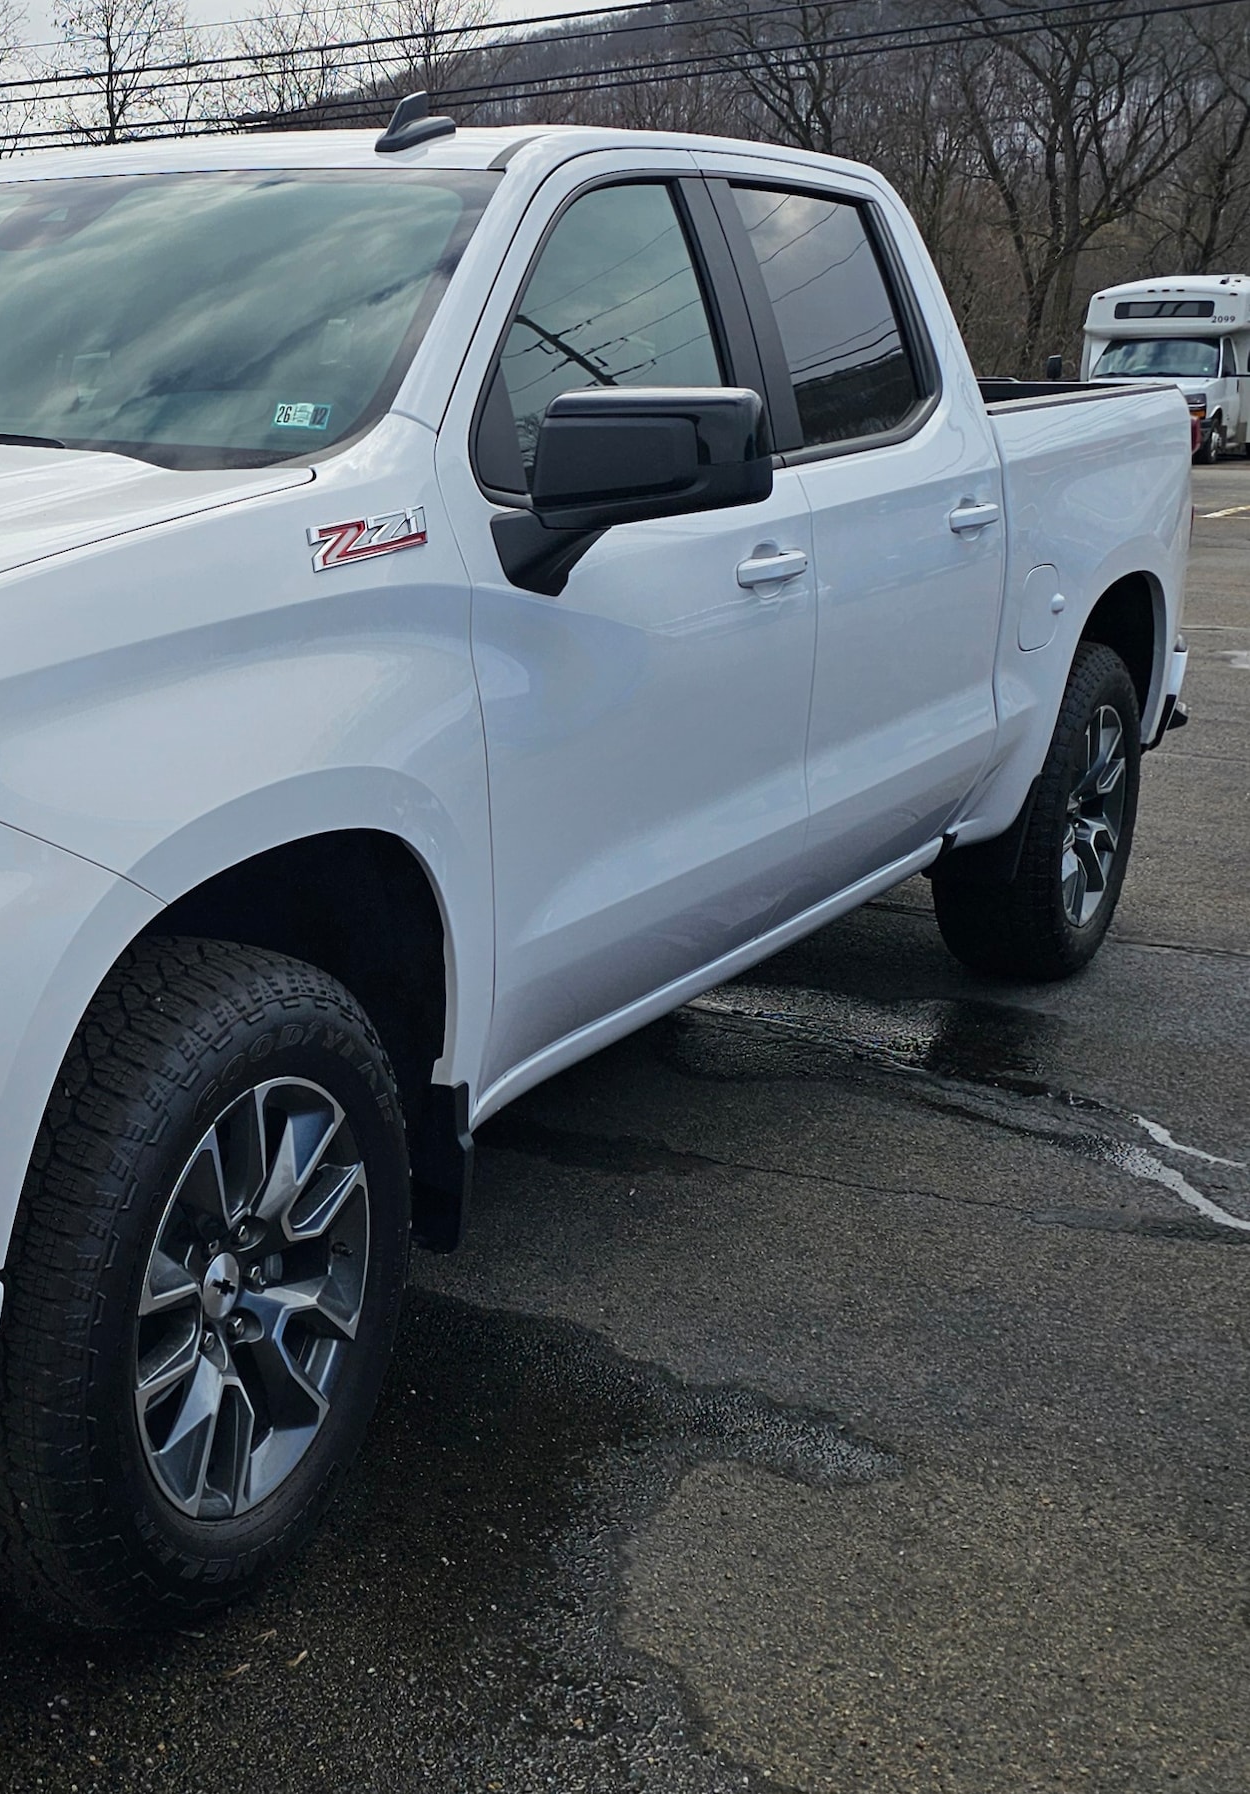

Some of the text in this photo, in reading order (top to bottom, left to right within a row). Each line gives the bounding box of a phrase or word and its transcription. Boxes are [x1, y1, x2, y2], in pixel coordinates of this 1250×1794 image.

[1211, 315, 1236, 324] 2099
[276, 405, 293, 423] 26
[311, 406, 329, 426] 12
[306, 505, 428, 573] Z71
